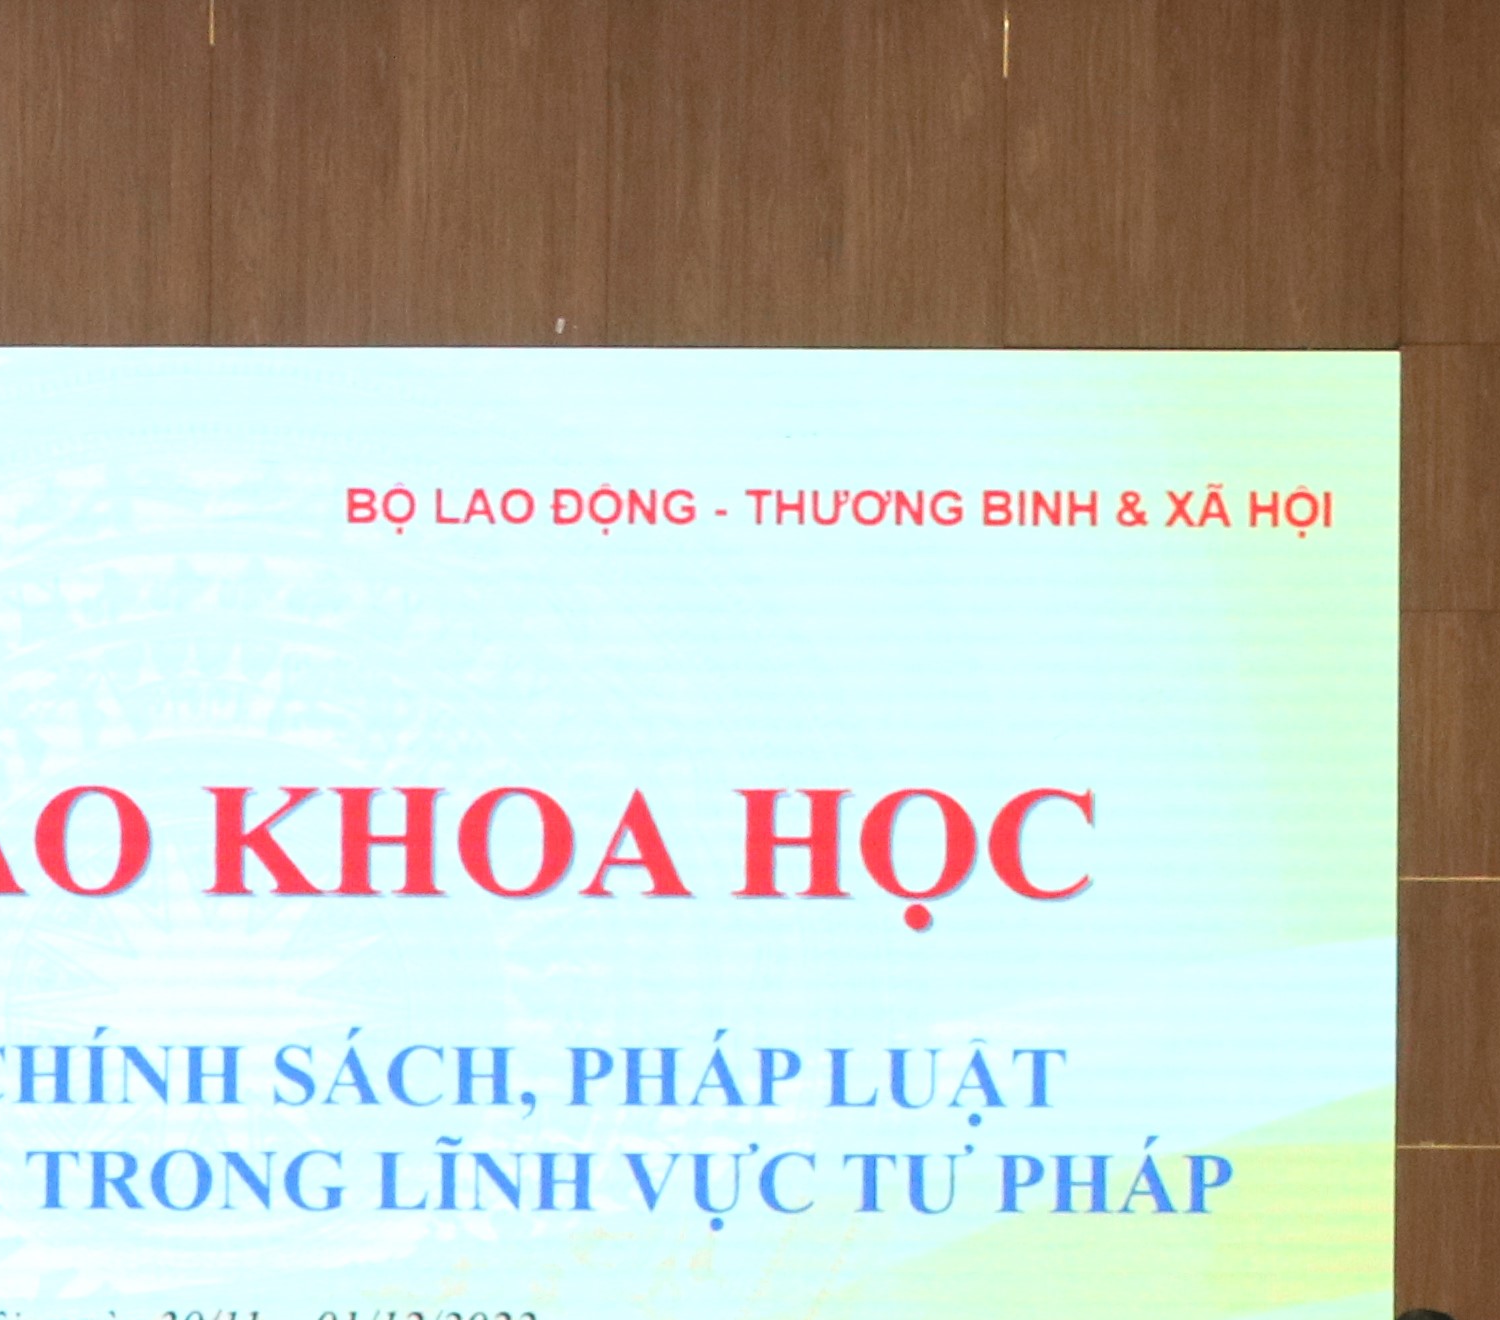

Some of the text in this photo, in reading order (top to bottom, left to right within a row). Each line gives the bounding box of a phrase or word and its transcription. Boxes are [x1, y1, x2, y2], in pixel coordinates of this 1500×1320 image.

[345, 480, 1333, 539] BỘ LAO ĐỘNG - THƯƠNG BINH & XÃ HỘI
[203, 786, 693, 900] KHOA
[733, 787, 1097, 934] HỌC
[273, 1026, 538, 1115] SÁCH,
[568, 1027, 804, 1108] PHÁP
[827, 1037, 1067, 1128] LUẬT
[25, 1147, 345, 1212] TRONG
[379, 1135, 595, 1212] LĨNH
[623, 1143, 818, 1233] VỰC
[842, 1143, 975, 1216] TƯ
[999, 1135, 1235, 1215] PHÁP
